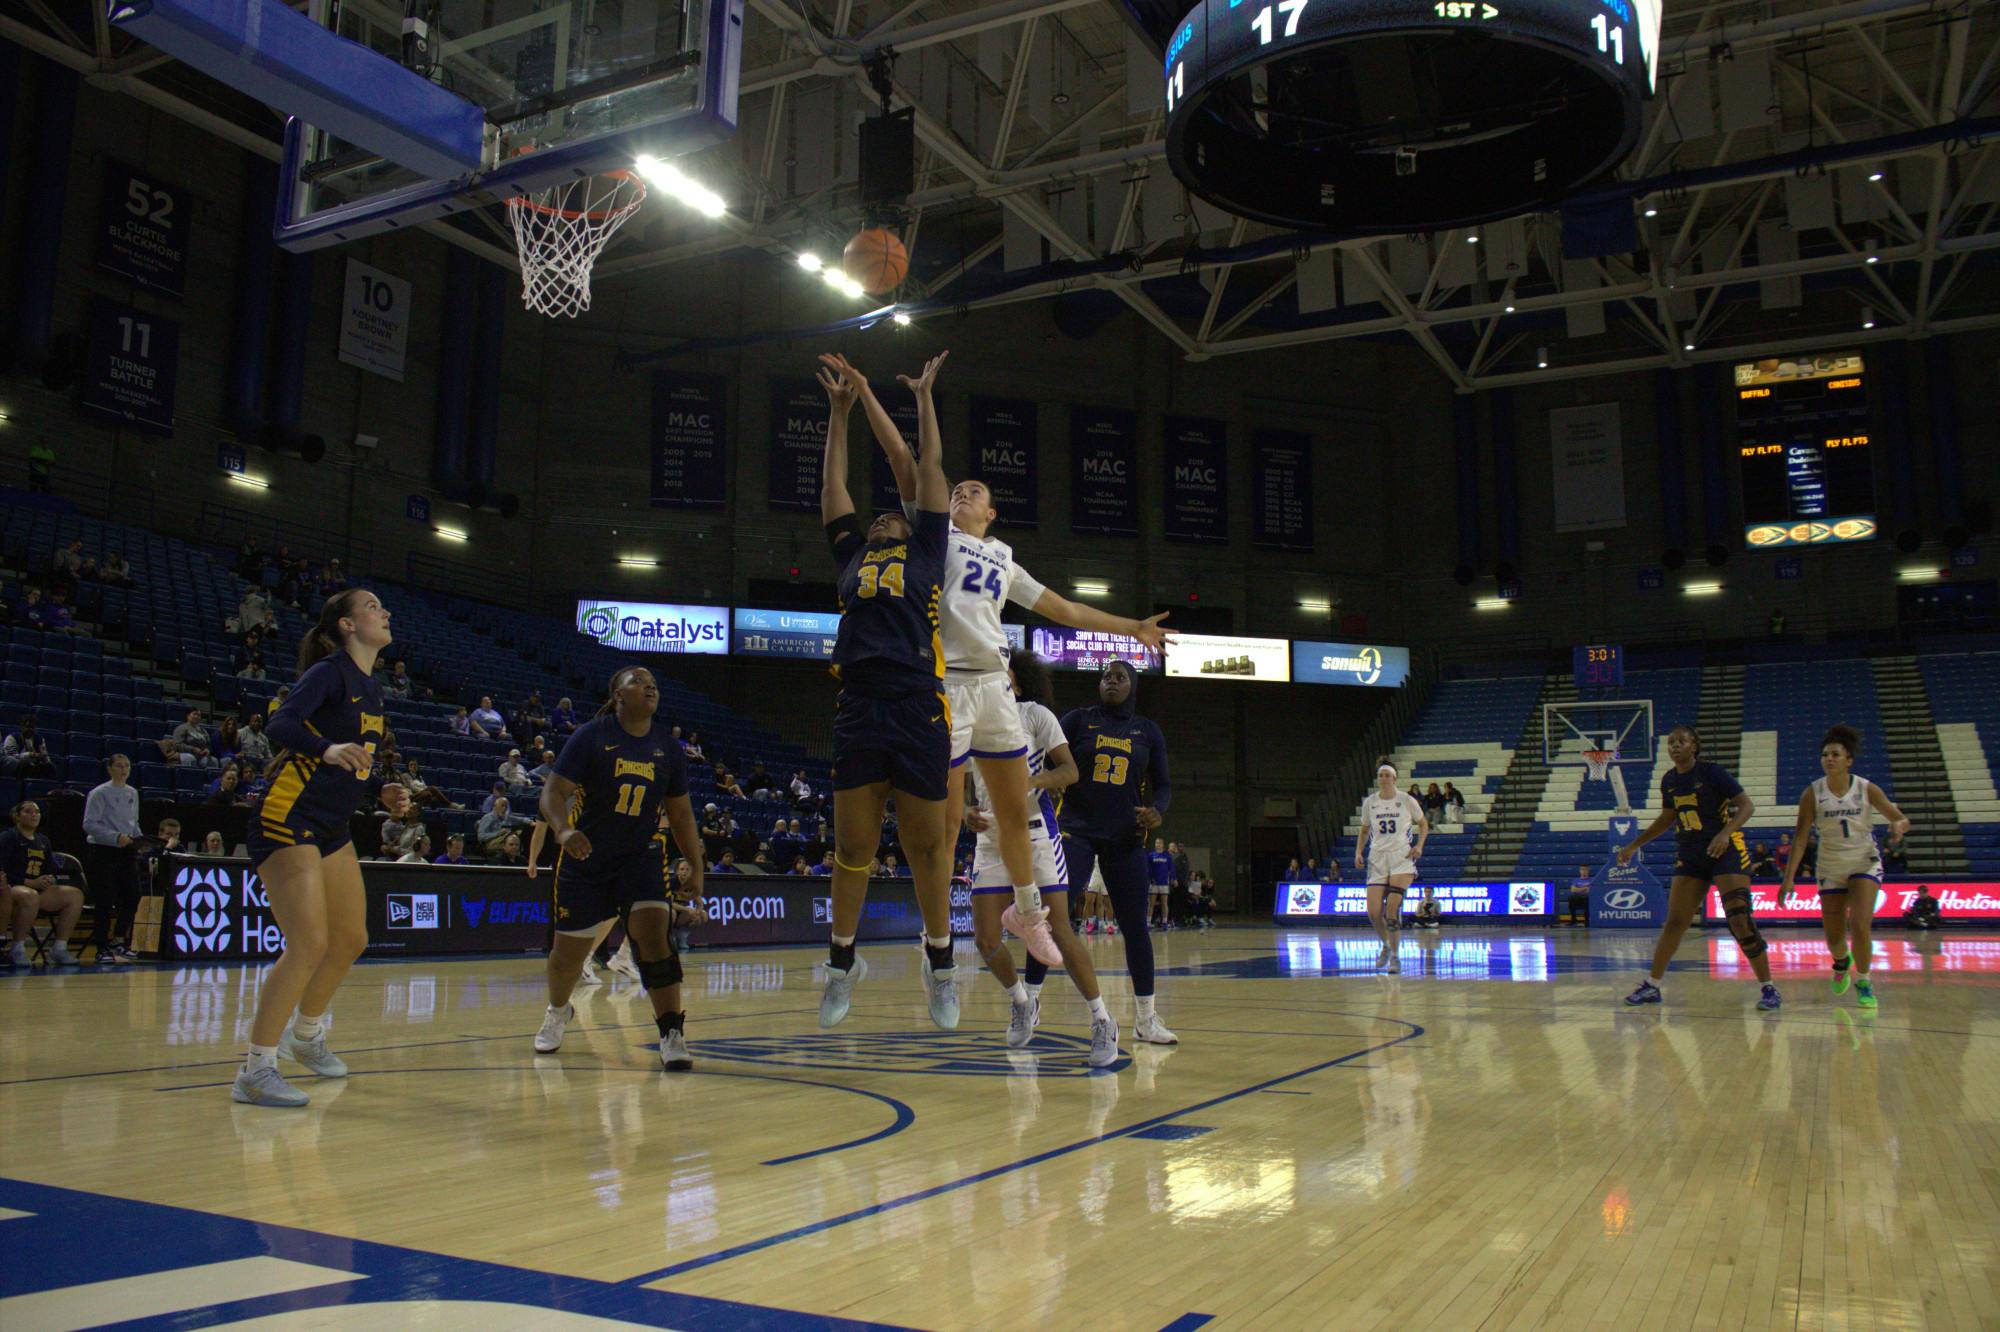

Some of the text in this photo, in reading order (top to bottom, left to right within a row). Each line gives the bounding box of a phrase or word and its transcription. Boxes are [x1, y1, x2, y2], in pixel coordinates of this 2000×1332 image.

[1434, 2, 1475, 18] 1ST
[1251, 0, 1308, 45] 17
[1591, 13, 1624, 64] 11
[1167, 61, 1184, 113] 11
[125, 177, 174, 230] 52
[126, 220, 167, 244] CURTIS
[109, 225, 182, 262] BLACKMORE
[361, 275, 393, 312] 10
[351, 308, 399, 333] KOURTNEY
[118, 316, 152, 359] 11
[358, 321, 393, 340] BROWN
[109, 354, 157, 379] TURNER
[110, 367, 154, 390] BATTLE
[1740, 388, 1771, 399] BUFFALO
[668, 411, 711, 429] MAC
[787, 417, 828, 435] MAC
[664, 435, 714, 446] CHAMPIONS
[223, 455, 241, 470] 115
[981, 447, 1026, 466] MAC
[1082, 456, 1126, 476] MAC
[982, 464, 1027, 475] CHAMPIONS
[1175, 465, 1216, 484] MAC
[1083, 474, 1126, 485] CHAMPIONS
[957, 544, 1007, 572] BUFFALO
[856, 562, 905, 600] 34
[961, 560, 1002, 601] 24
[622, 616, 724, 645] Catalyst
[1075, 631, 1092, 641] SHOW
[1093, 632, 1109, 642] YOUR
[771, 639, 816, 647] AMERICAN
[1066, 640, 1087, 651] SOCIAL
[1088, 642, 1102, 652] CLUB
[1103, 642, 1114, 653] FOR
[1115, 643, 1129, 653] FREE
[1130, 644, 1144, 654] SLOT
[1588, 649, 1616, 663] 3:01
[1095, 734, 1133, 755] CANISIUS
[613, 757, 655, 783] CANISIUS
[1092, 753, 1130, 786] 23
[614, 783, 647, 817] 11
[1375, 812, 1400, 820] BUFFALO
[1824, 808, 1862, 818] BUFFALO
[1379, 820, 1397, 835] 33
[1840, 819, 1850, 839] 1
[1452, 887, 1488, 898] UNIONS
[415, 901, 435, 912] NEW
[487, 901, 550, 925] BUFFAL
[1455, 899, 1492, 913] UNITY
[1598, 910, 1652, 920] HYUNDAI
[415, 912, 435, 922] ERA
